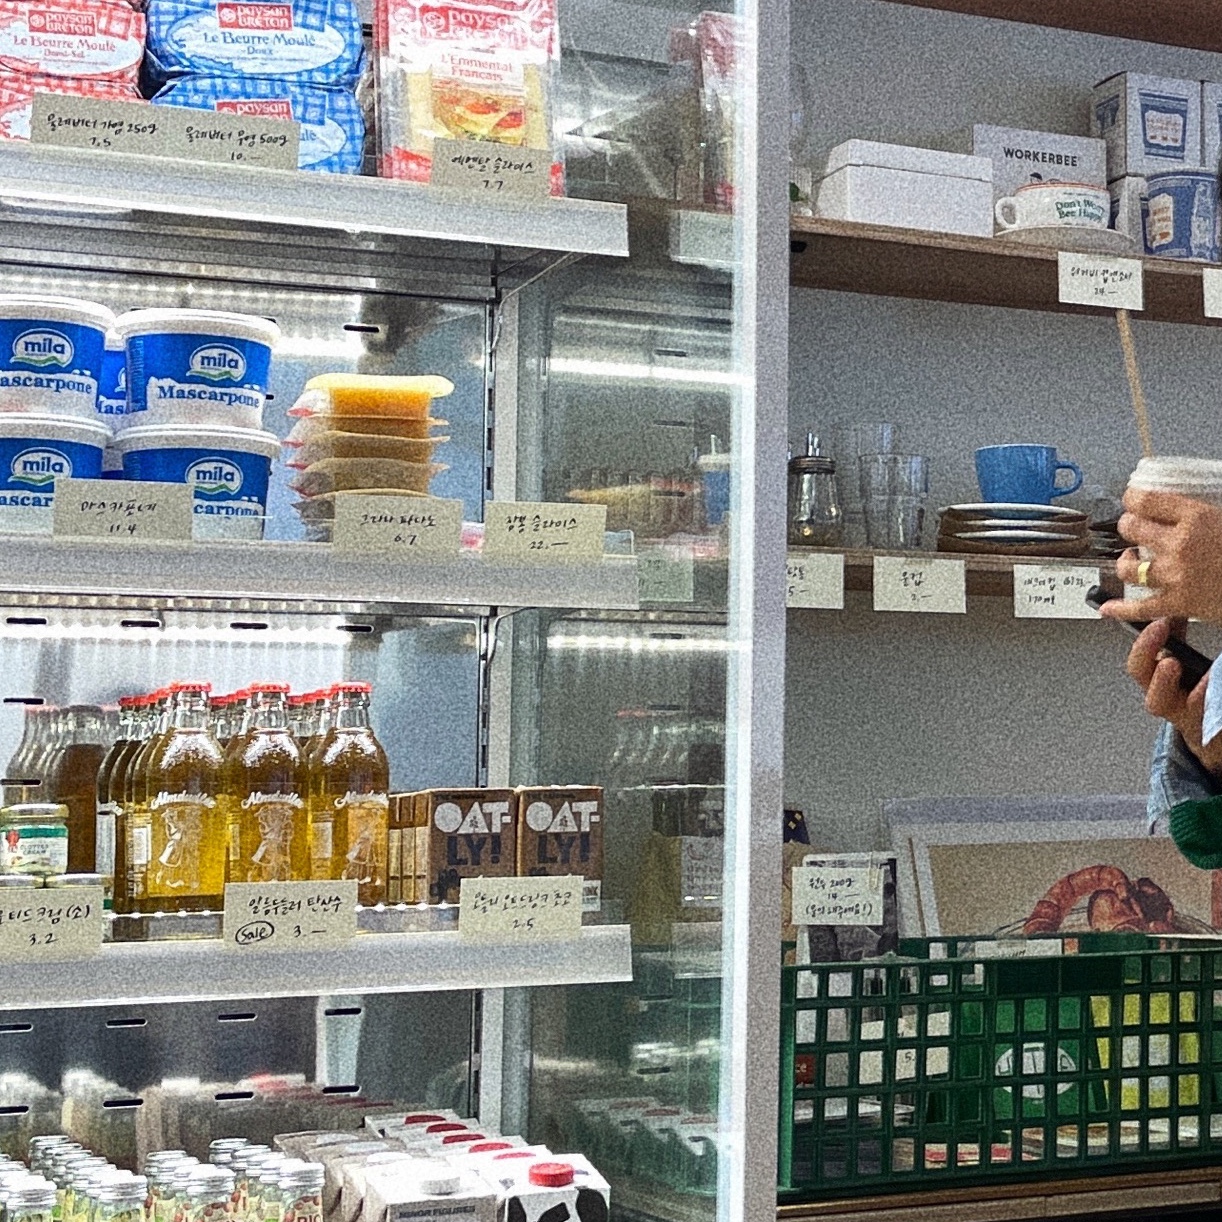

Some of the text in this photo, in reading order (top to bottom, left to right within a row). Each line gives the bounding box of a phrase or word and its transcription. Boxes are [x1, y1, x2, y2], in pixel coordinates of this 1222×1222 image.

[449, 9, 510, 30] paysa
[14, 35, 117, 53] Le Beurre Moulé
[203, 32, 316, 47] Le Beurre Moulé
[127, 122, 159, 135] 250g
[259, 133, 288, 147] 500g
[493, 156, 535, 175] 슬라이스
[1003, 147, 1079, 167] WORKERBEE
[24, 337, 65, 355] mila
[200, 352, 239, 370] mila
[0, 374, 92, 394] ascarpone
[158, 385, 260, 408] Mascarpone
[22, 455, 64, 474] mila
[195, 466, 235, 484] mila
[0, 494, 53, 507] ascar
[194, 502, 259, 517] carpone
[530, 515, 578, 532] 슬라이스
[447, 833, 501, 866] LY!
[537, 832, 591, 864] LY!
[307, 894, 343, 913] 탄산수
